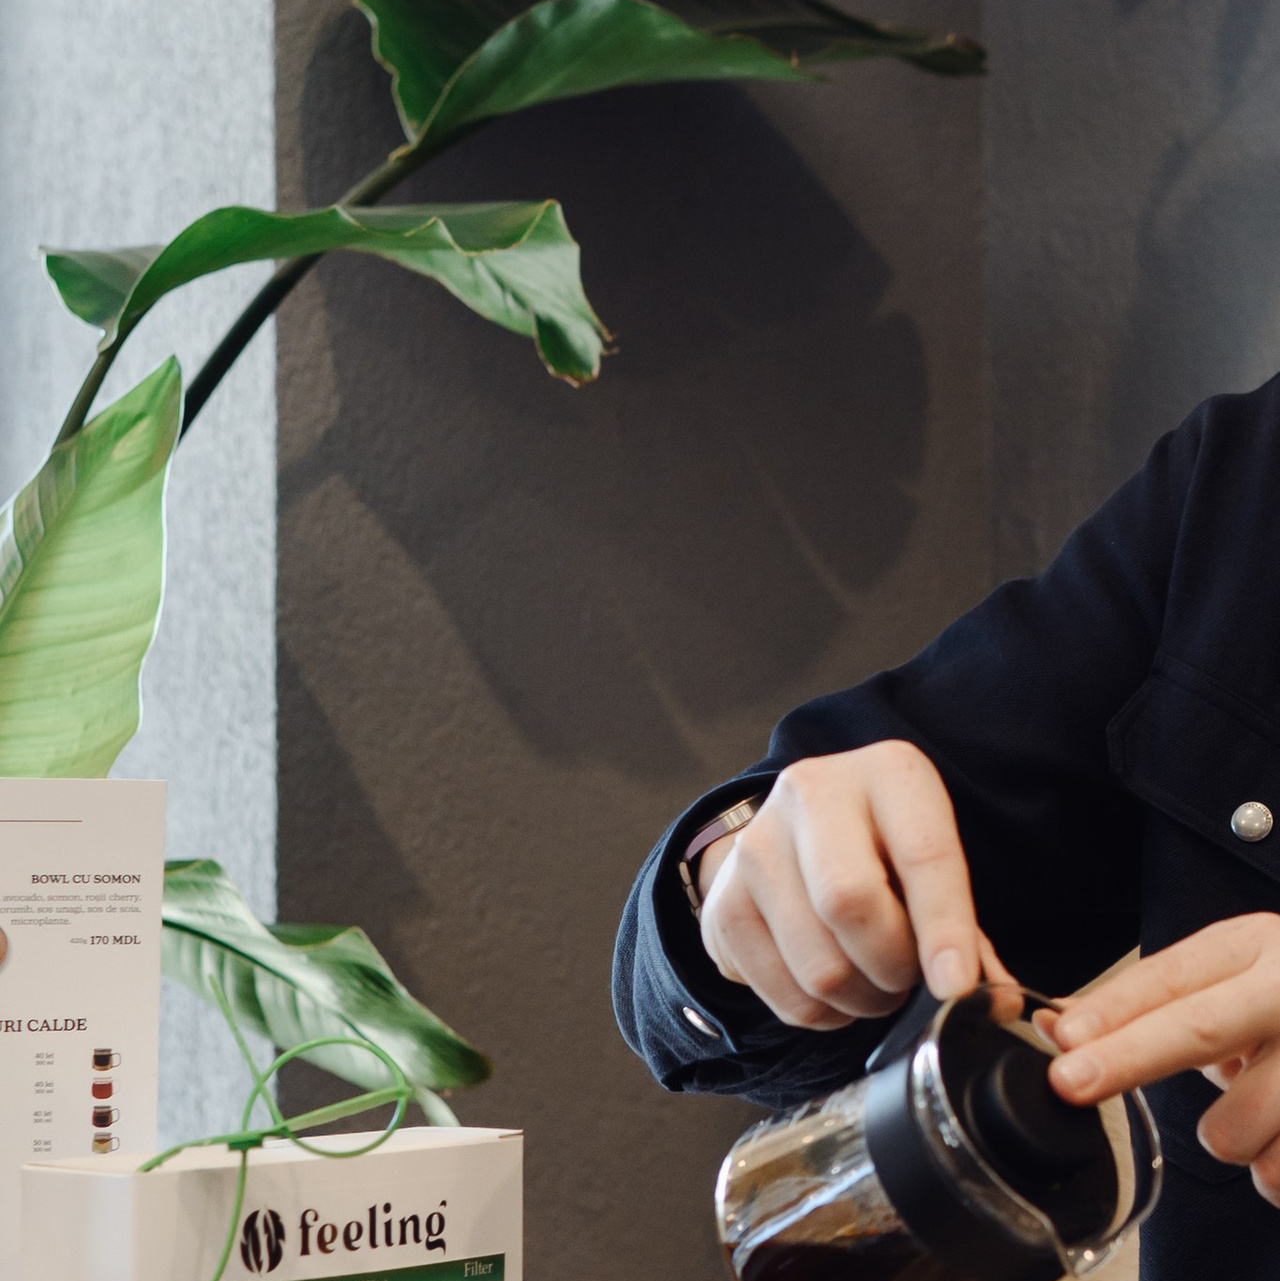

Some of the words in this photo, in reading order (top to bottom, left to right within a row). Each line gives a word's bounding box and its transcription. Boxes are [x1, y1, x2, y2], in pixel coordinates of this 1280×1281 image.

[31, 874, 70, 884] BOWL
[72, 874, 91, 884] CU
[93, 874, 141, 884] SOMON
[90, 935, 109, 945] 170
[112, 935, 141, 945] MDL
[27, 1018, 88, 1032] CALDE
[298, 1200, 447, 1257] feeling
[463, 1261, 494, 1278] Filter
